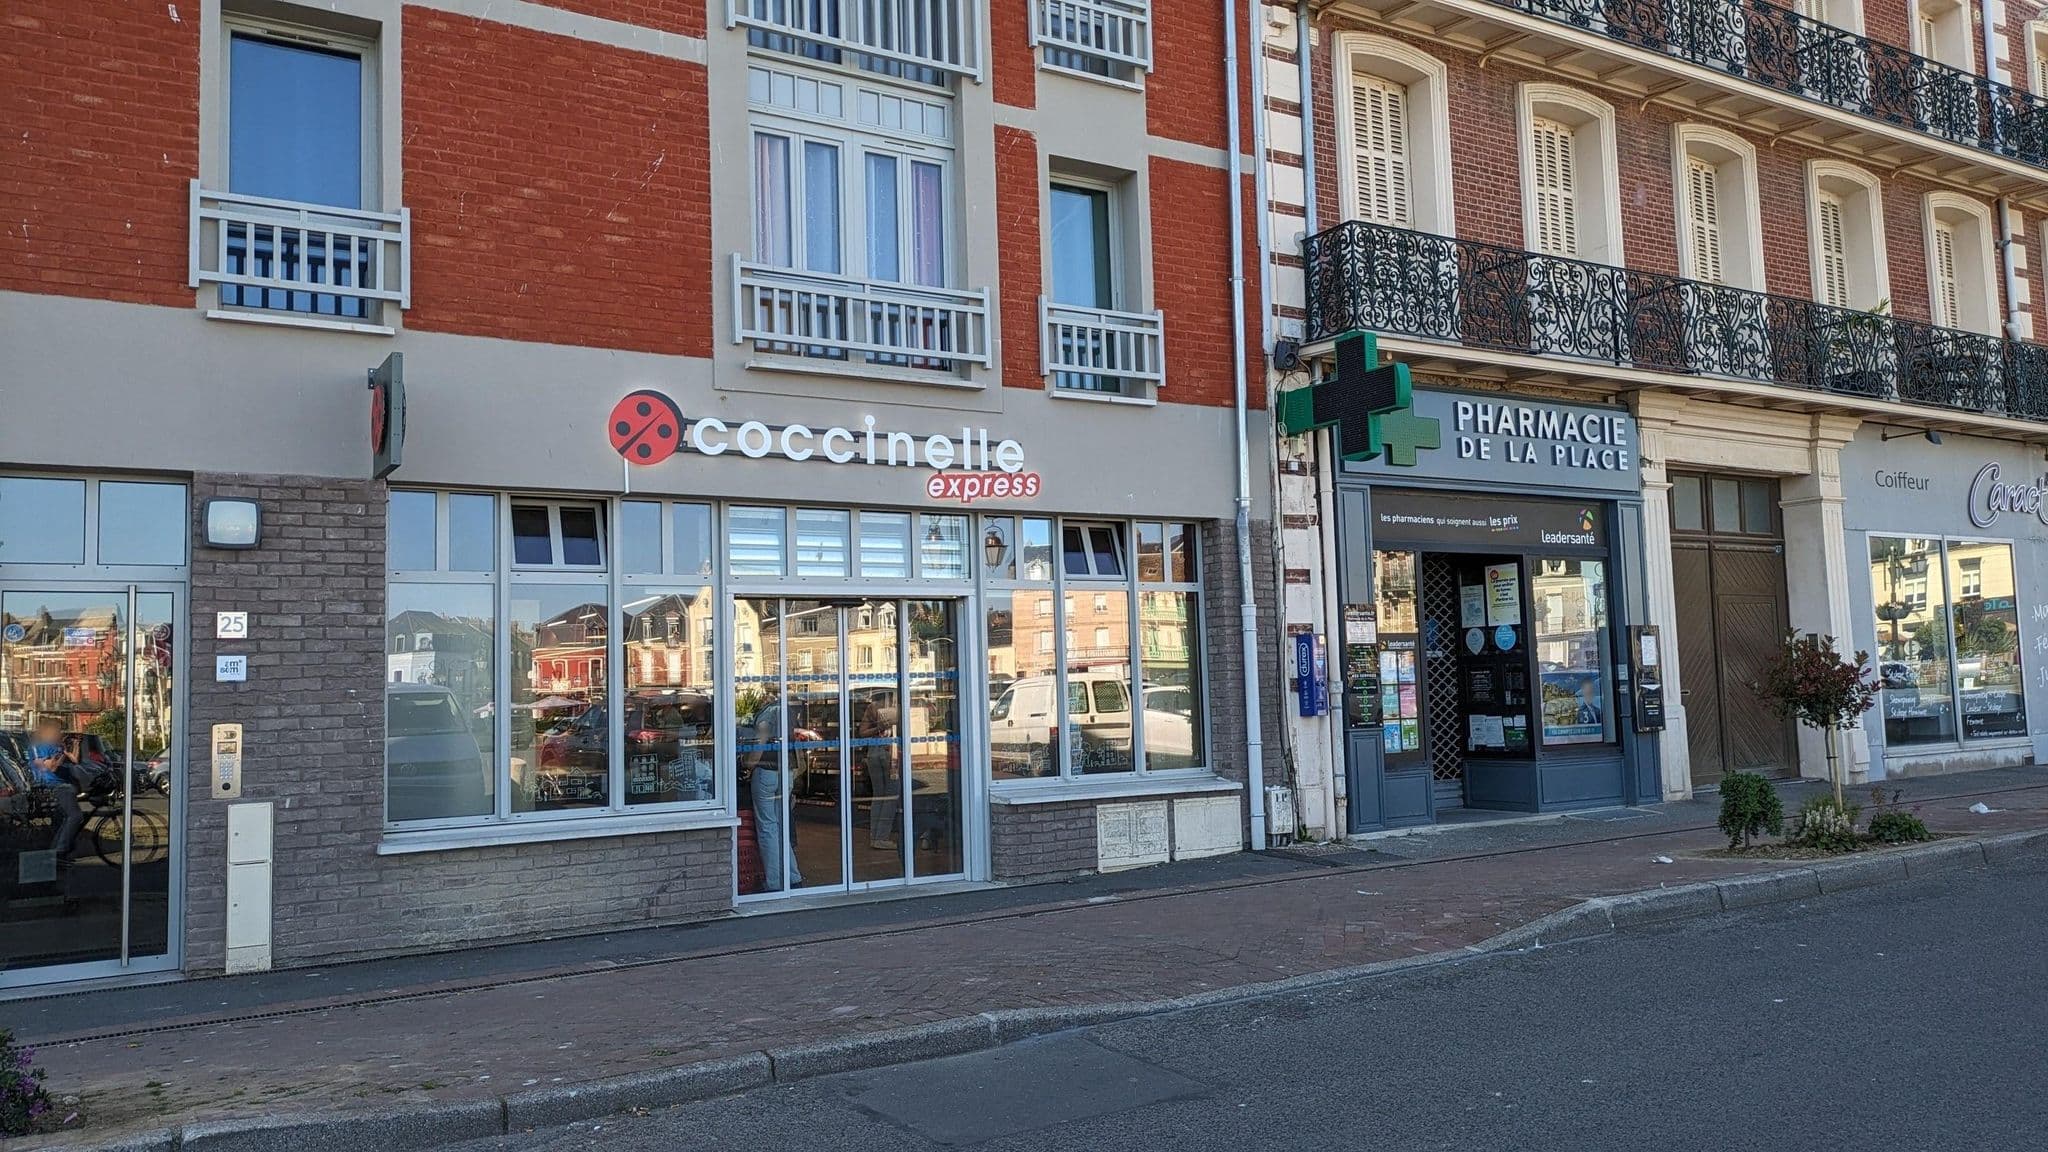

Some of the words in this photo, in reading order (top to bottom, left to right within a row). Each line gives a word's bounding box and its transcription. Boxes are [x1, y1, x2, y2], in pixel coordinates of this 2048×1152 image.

[1456, 400, 1627, 446] PHARMACIE
[692, 414, 1025, 473] coccinelle
[1461, 437, 1491, 460] DE
[1509, 440, 1538, 464] LA
[1556, 444, 1629, 470] PLACE
[927, 473, 1040, 502] express
[1875, 470, 1930, 491] Coiffeur
[1380, 513, 1391, 522] les
[1392, 514, 1435, 524] pharmaciens
[1436, 517, 1446, 526] qui
[1447, 517, 1471, 527] soignent
[1472, 518, 1487, 526] aussi
[1489, 516, 1501, 526] les
[1502, 514, 1518, 528] prix
[1541, 529, 1595, 545] leadersanté
[219, 616, 244, 633] 25
